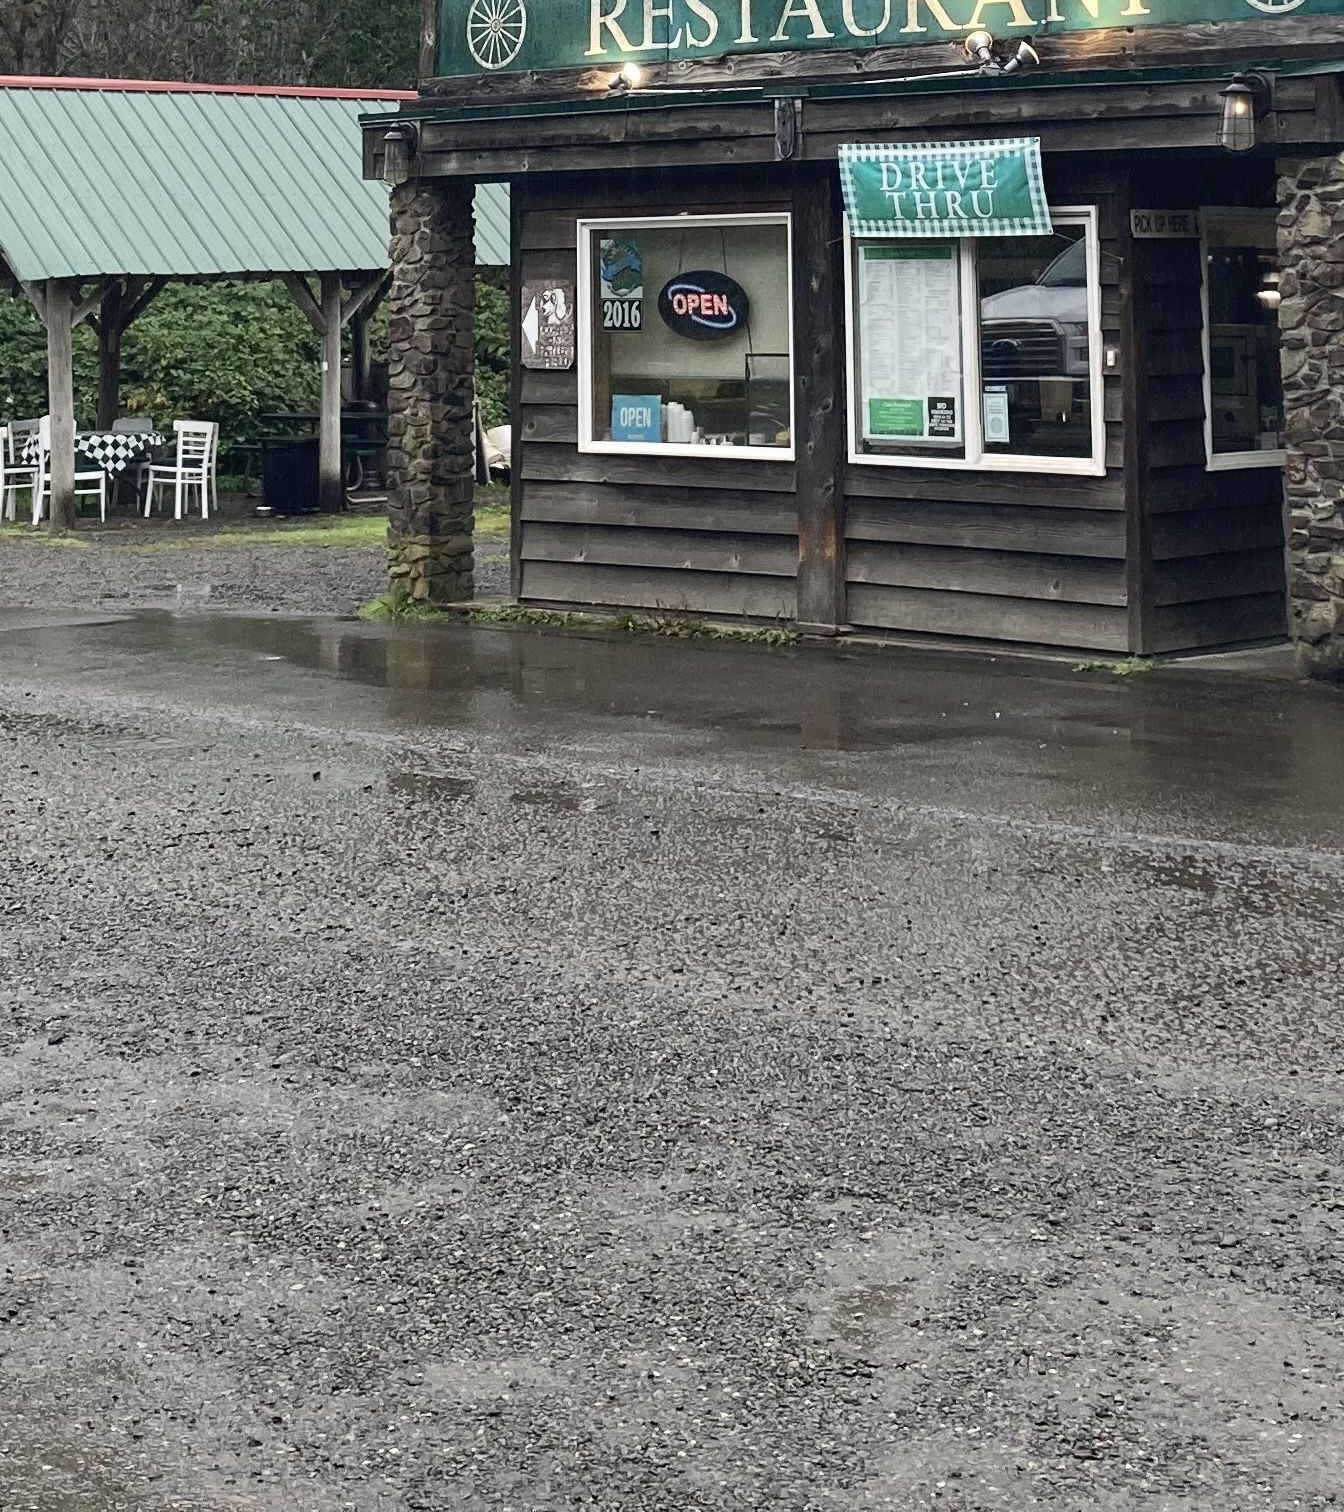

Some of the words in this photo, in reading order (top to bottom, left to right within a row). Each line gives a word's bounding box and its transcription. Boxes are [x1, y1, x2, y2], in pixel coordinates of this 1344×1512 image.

[880, 160, 998, 190] DRIVE
[885, 190, 994, 219] THRU
[1134, 214, 1153, 234] PICK
[1154, 214, 1165, 234] UP
[603, 300, 641, 328] 2016
[672, 293, 728, 315] OPEN
[620, 406, 652, 428] OPEN
